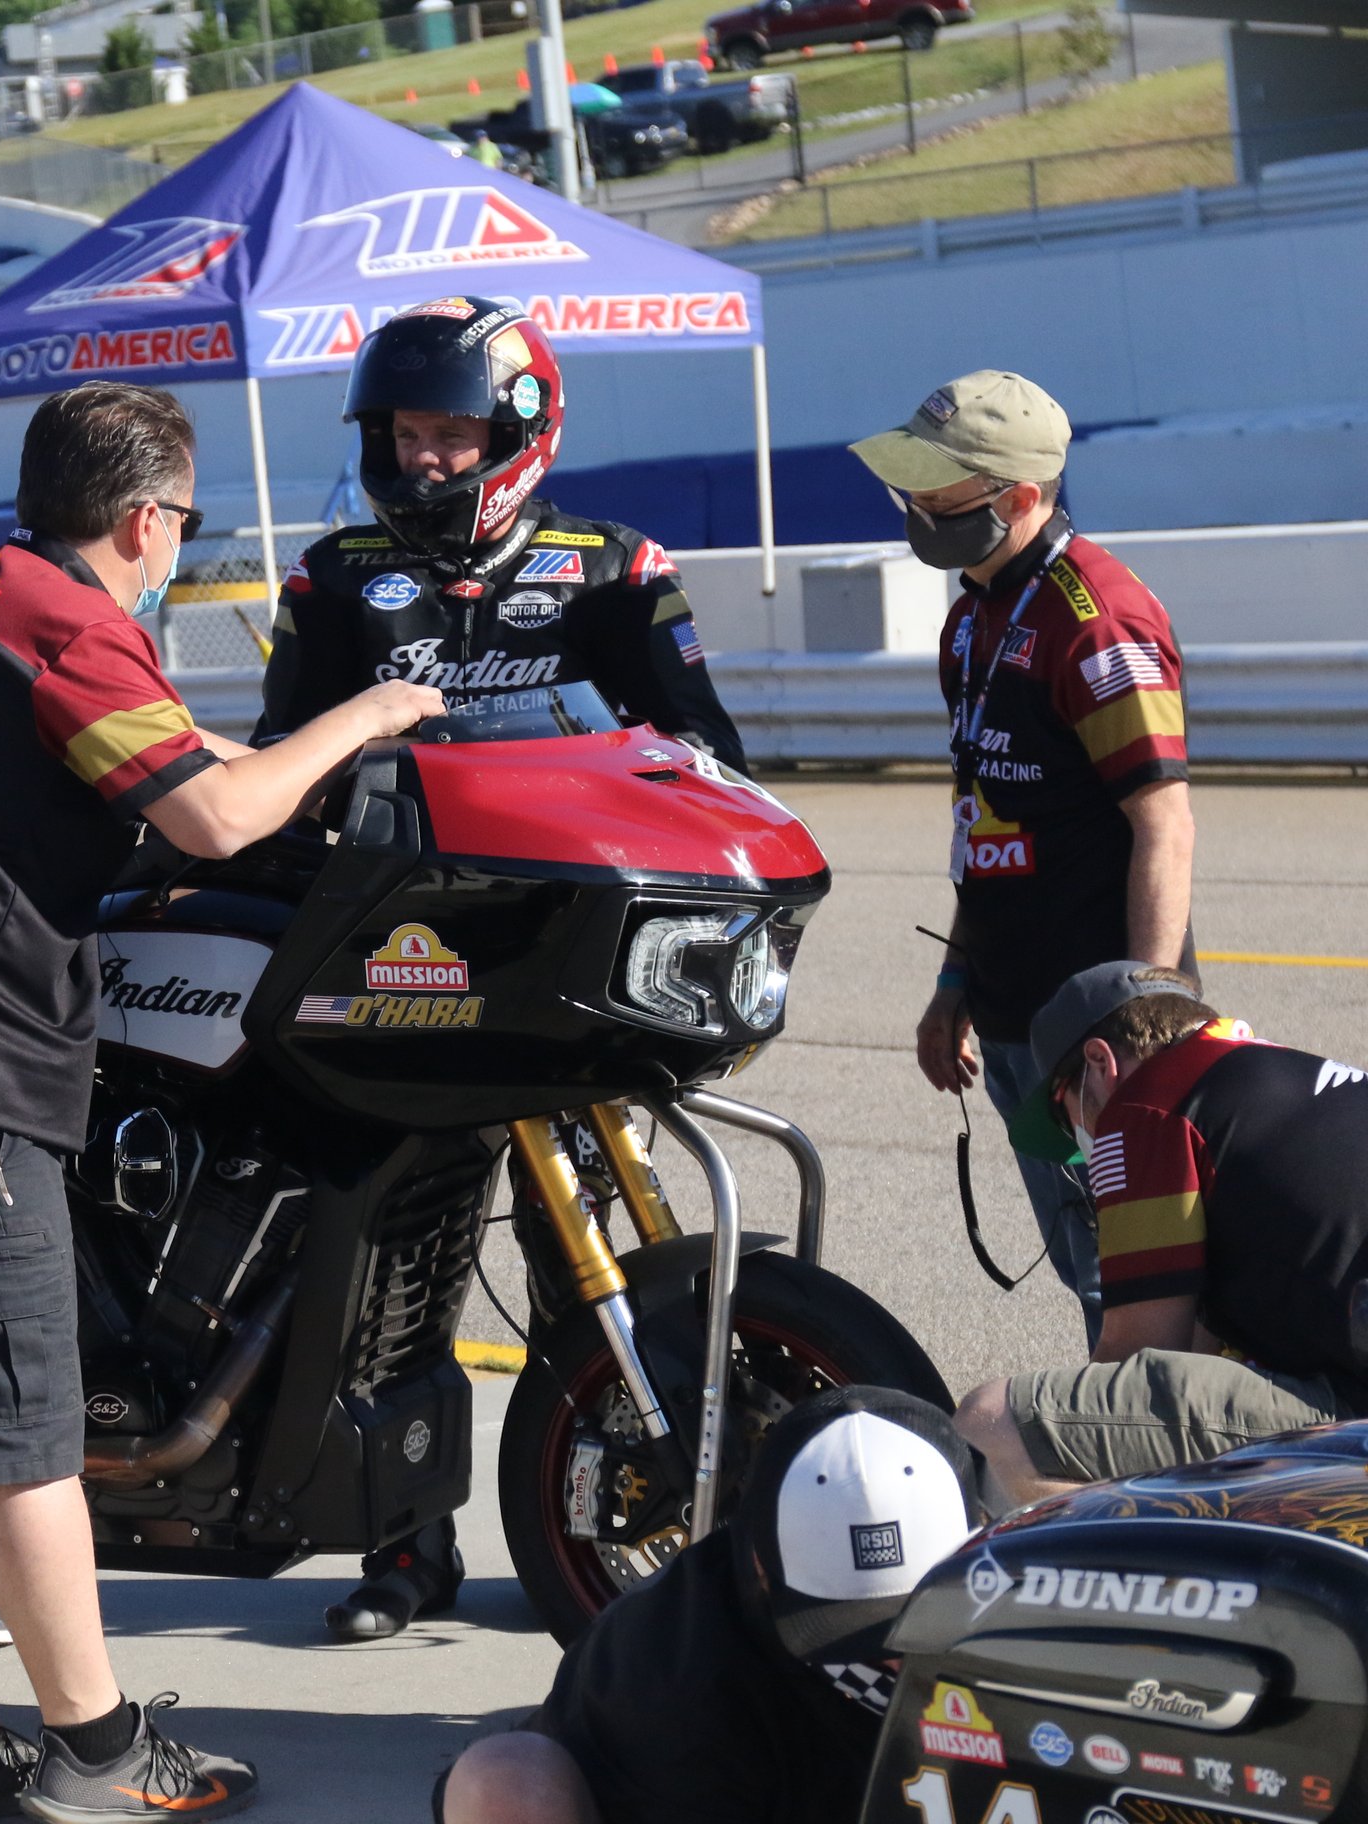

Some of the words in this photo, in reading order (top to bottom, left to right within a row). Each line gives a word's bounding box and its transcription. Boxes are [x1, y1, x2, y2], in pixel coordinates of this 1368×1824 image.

[367, 243, 580, 272] MOTOAMERICA
[481, 456, 542, 521] Indian
[482, 487, 531, 532] MOTORCYCLE
[543, 533, 600, 543] DUNLOP
[372, 583, 411, 599] S&S
[1054, 563, 1095, 616] DUNLOP
[502, 604, 537, 617] MOTOR
[540, 604, 558, 616] OIL
[376, 638, 562, 690] Indian
[978, 758, 1044, 781] RACING
[101, 958, 242, 1018] Indian
[370, 965, 464, 985] MISSION
[344, 994, 485, 1027] O'HARA
[92, 1402, 120, 1414] S&S
[407, 1429, 428, 1450] S&S
[574, 1466, 587, 1516] brembo
[859, 1530, 894, 1549] RSD
[1016, 1566, 1259, 1621] DUNLOP
[1130, 1680, 1206, 1721] Indian
[922, 1724, 1004, 1764] MISSION
[1035, 1732, 1071, 1755] S&S
[1091, 1744, 1127, 1765] BELL
[1141, 1753, 1183, 1774] MOTUL
